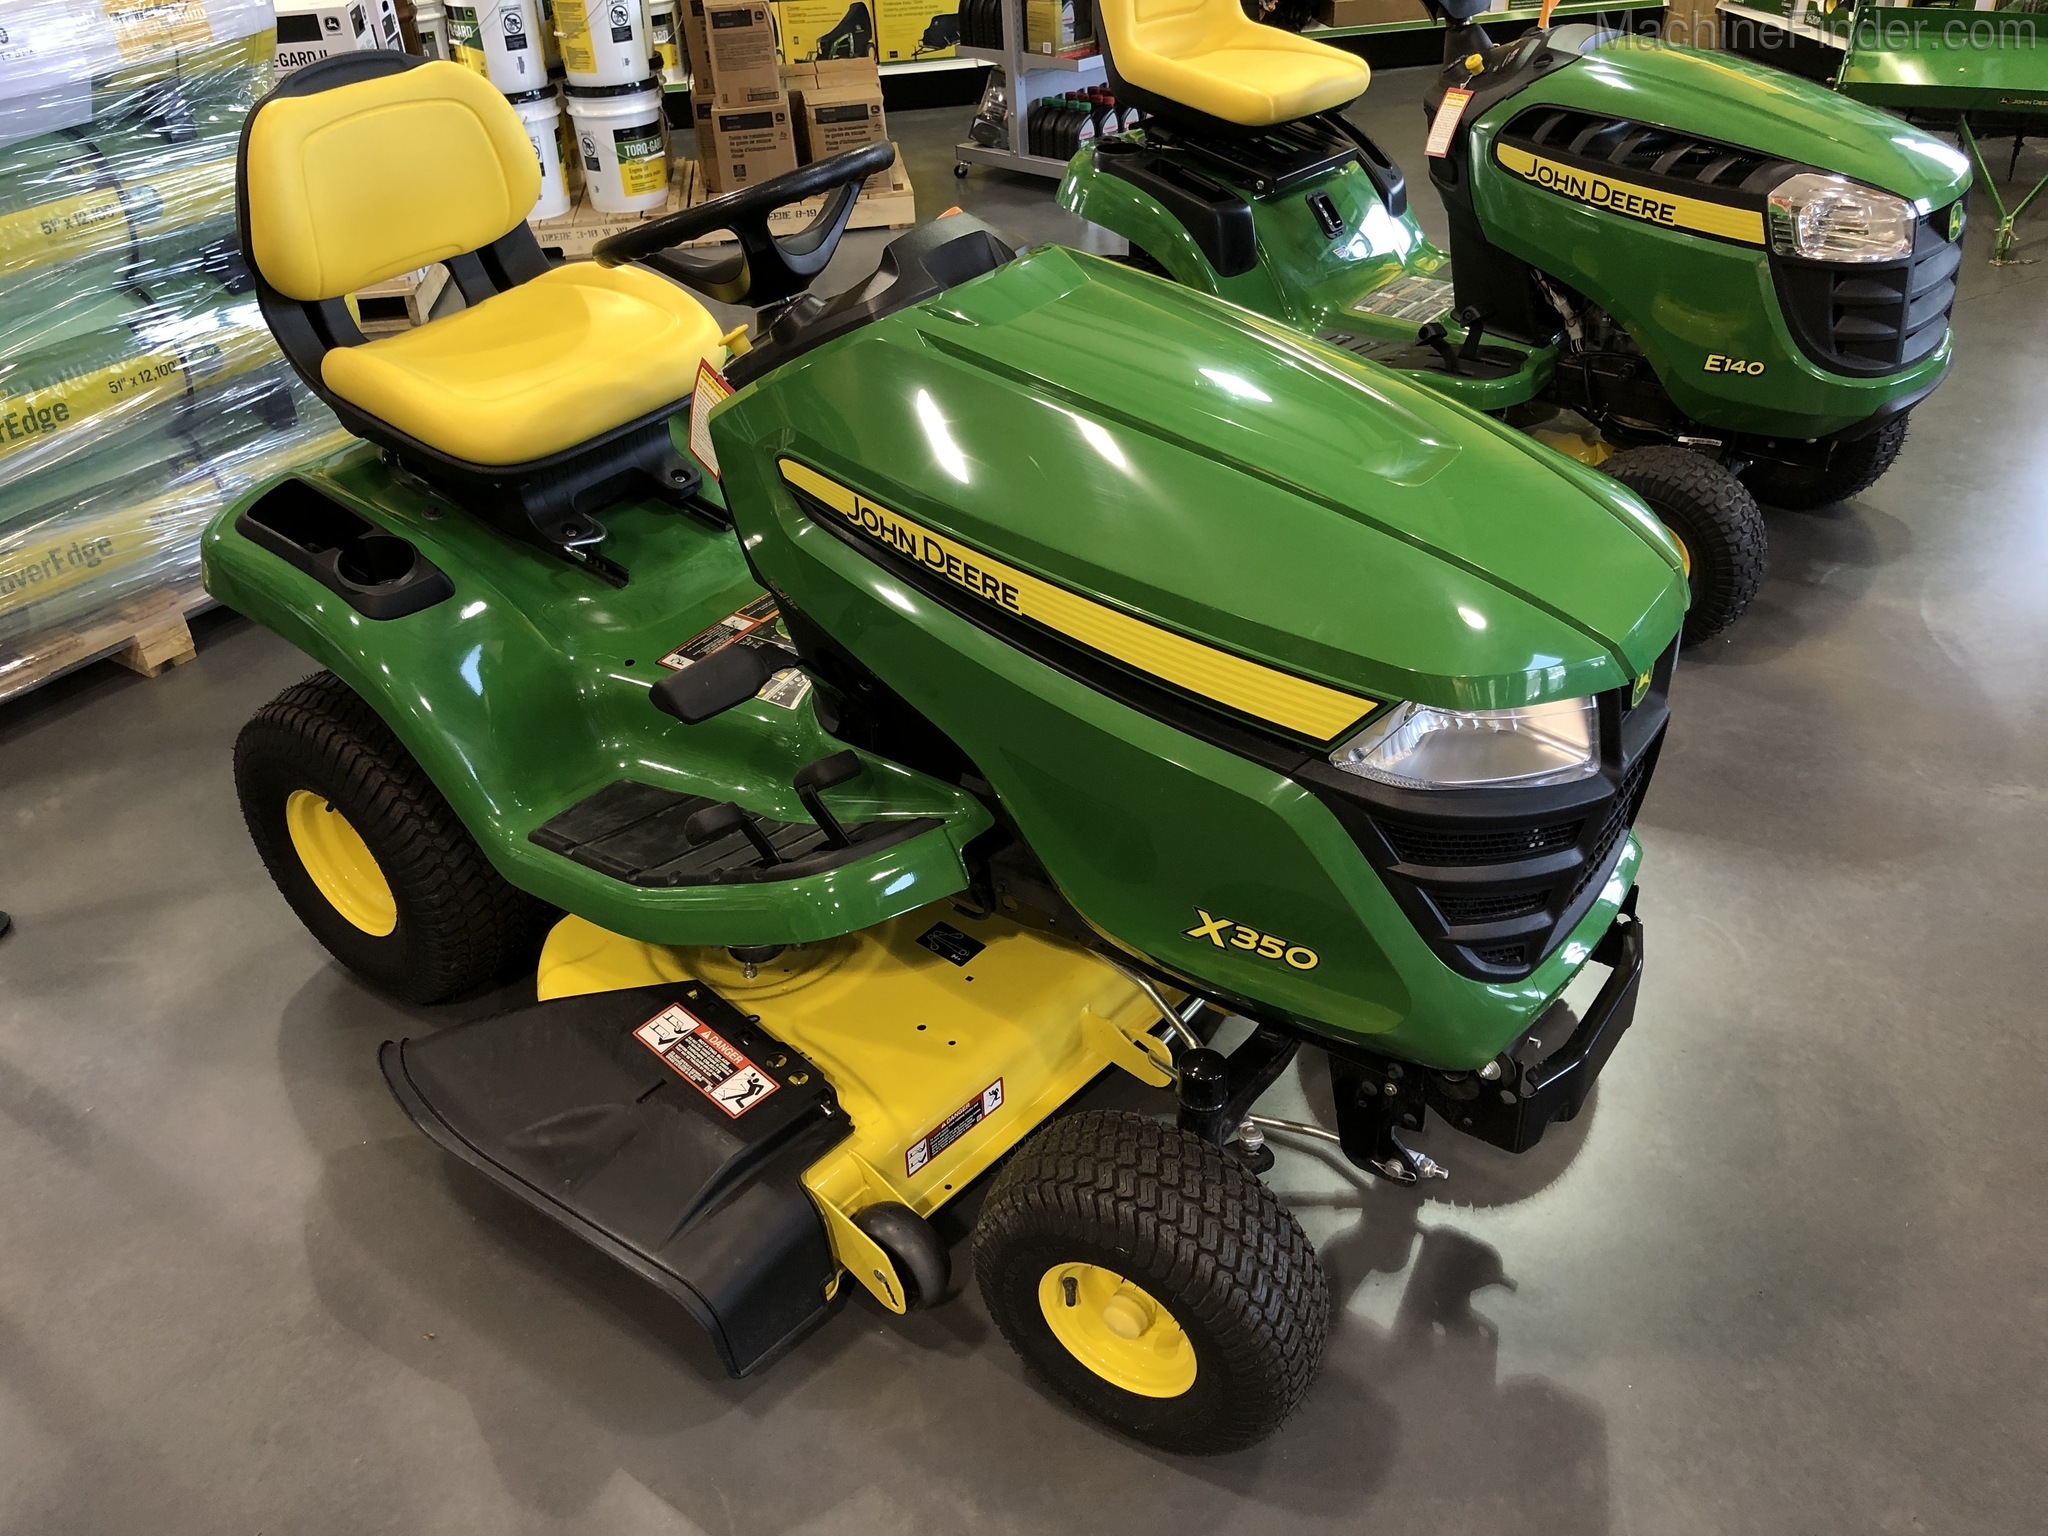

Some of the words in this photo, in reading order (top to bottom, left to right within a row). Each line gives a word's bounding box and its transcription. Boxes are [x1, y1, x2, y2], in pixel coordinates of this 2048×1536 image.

[274, 51, 317, 68] -GARD
[1524, 158, 1587, 199] JOHN
[1591, 179, 1677, 225] DEERE
[1704, 354, 1765, 377] E140
[108, 377, 126, 394] 51"
[131, 376, 138, 387] x
[847, 496, 916, 558] JOHN
[923, 534, 1020, 612] DEERE
[1186, 909, 1319, 971] X350
[709, 1035, 744, 1065] DANGER
[946, 1102, 971, 1125] DANGER
